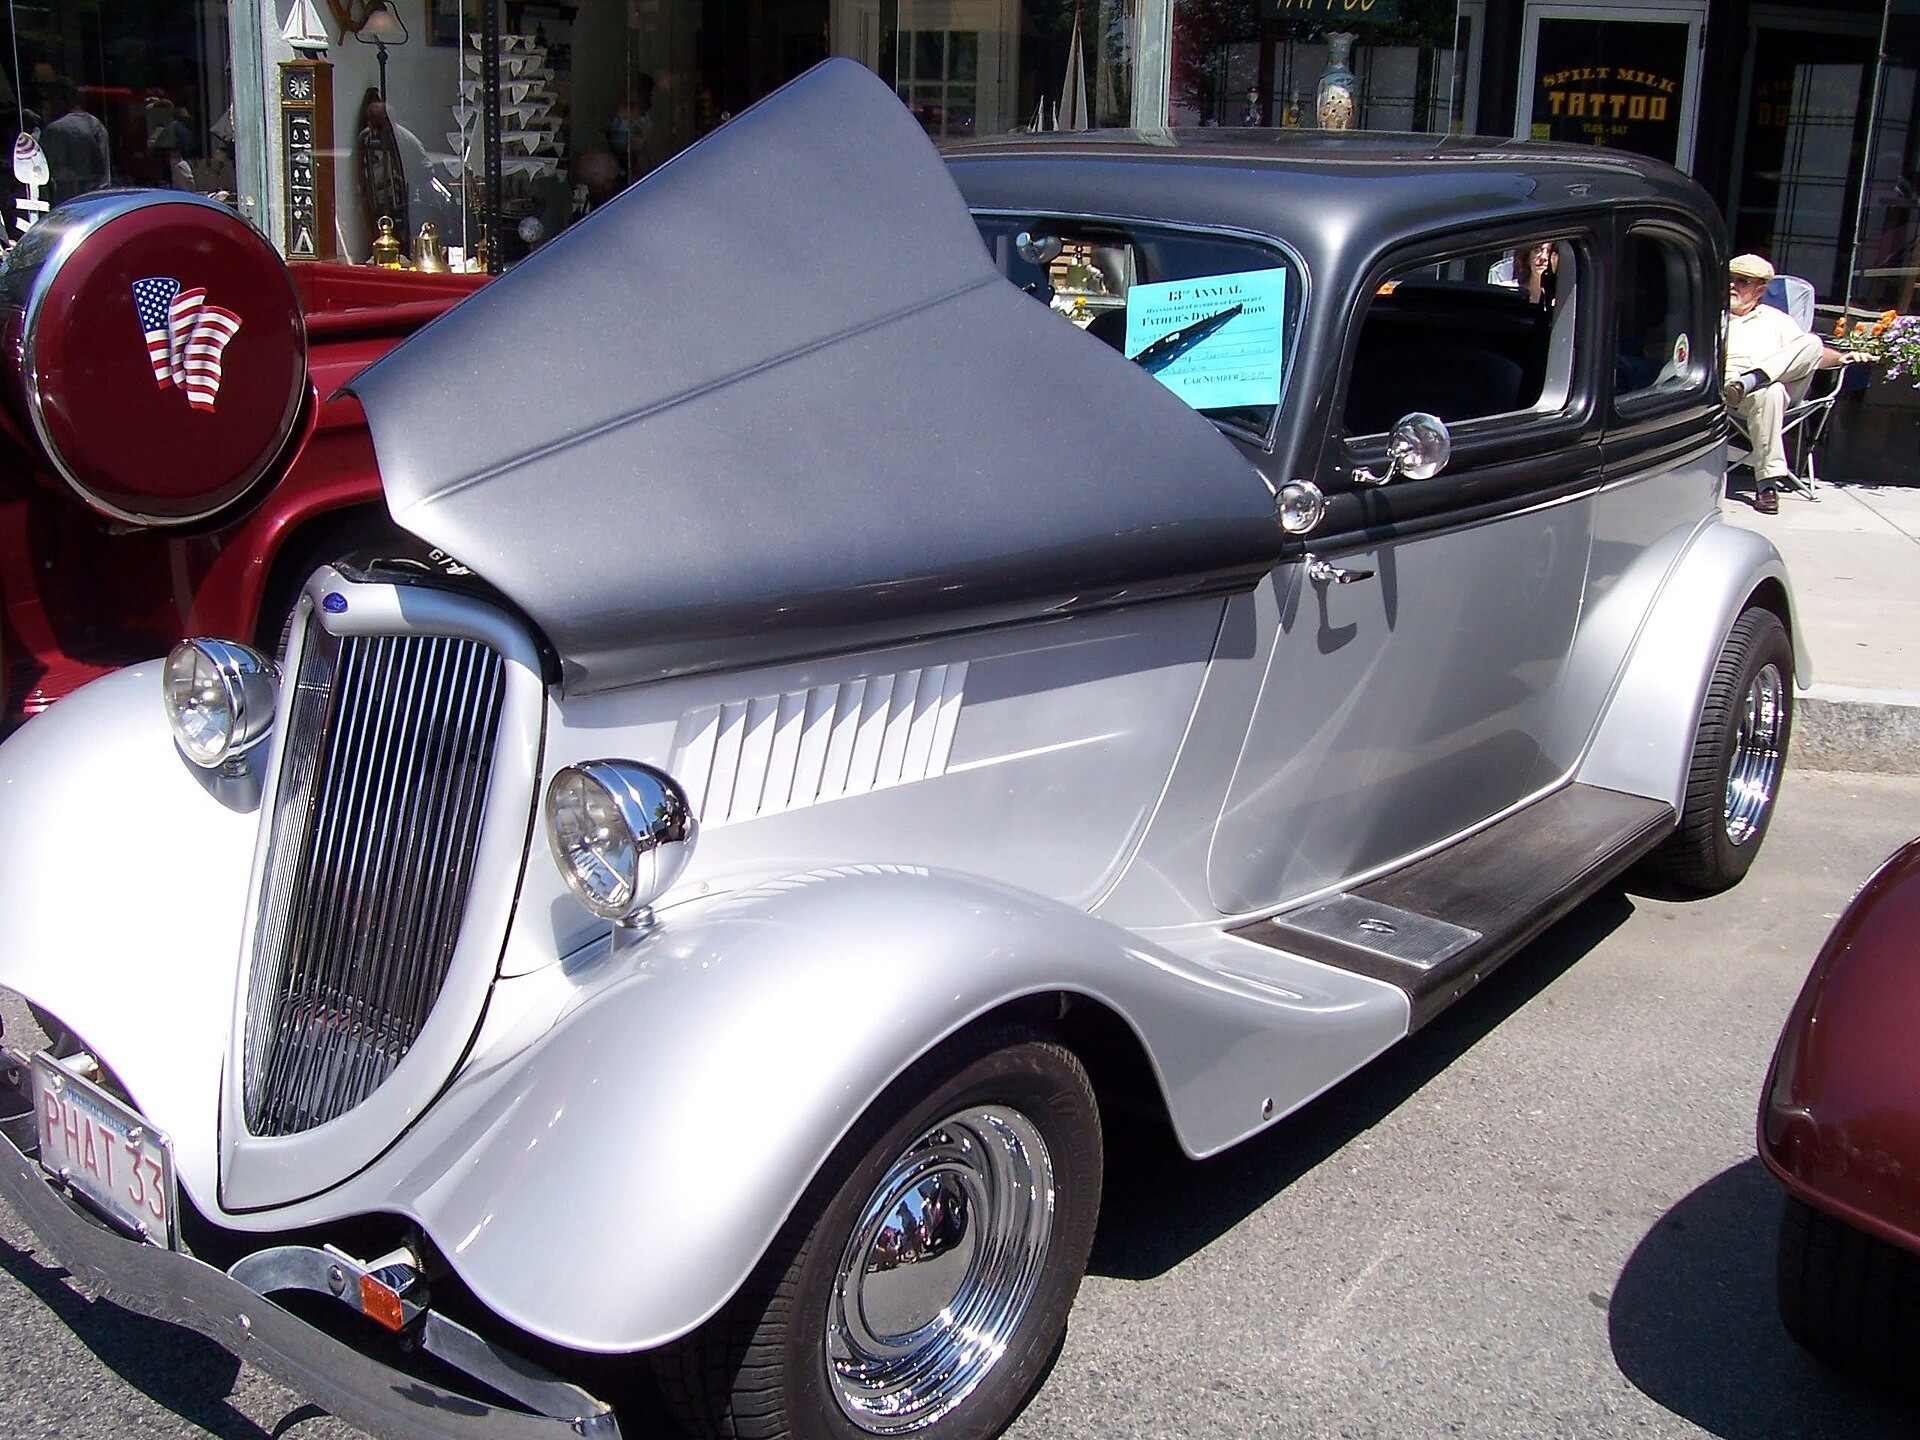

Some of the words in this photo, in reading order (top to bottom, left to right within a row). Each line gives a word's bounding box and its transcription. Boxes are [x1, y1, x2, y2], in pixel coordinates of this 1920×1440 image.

[1543, 67, 1610, 87] SPILT
[1617, 68, 1675, 93] MILK
[1549, 91, 1667, 120] TATTOO
[1193, 285, 1242, 299] ANNUAL
[1183, 376, 1201, 385] CAR
[1203, 373, 1239, 384] NUMBER
[43, 1088, 116, 1188] PHAT
[125, 1142, 164, 1220] 33
